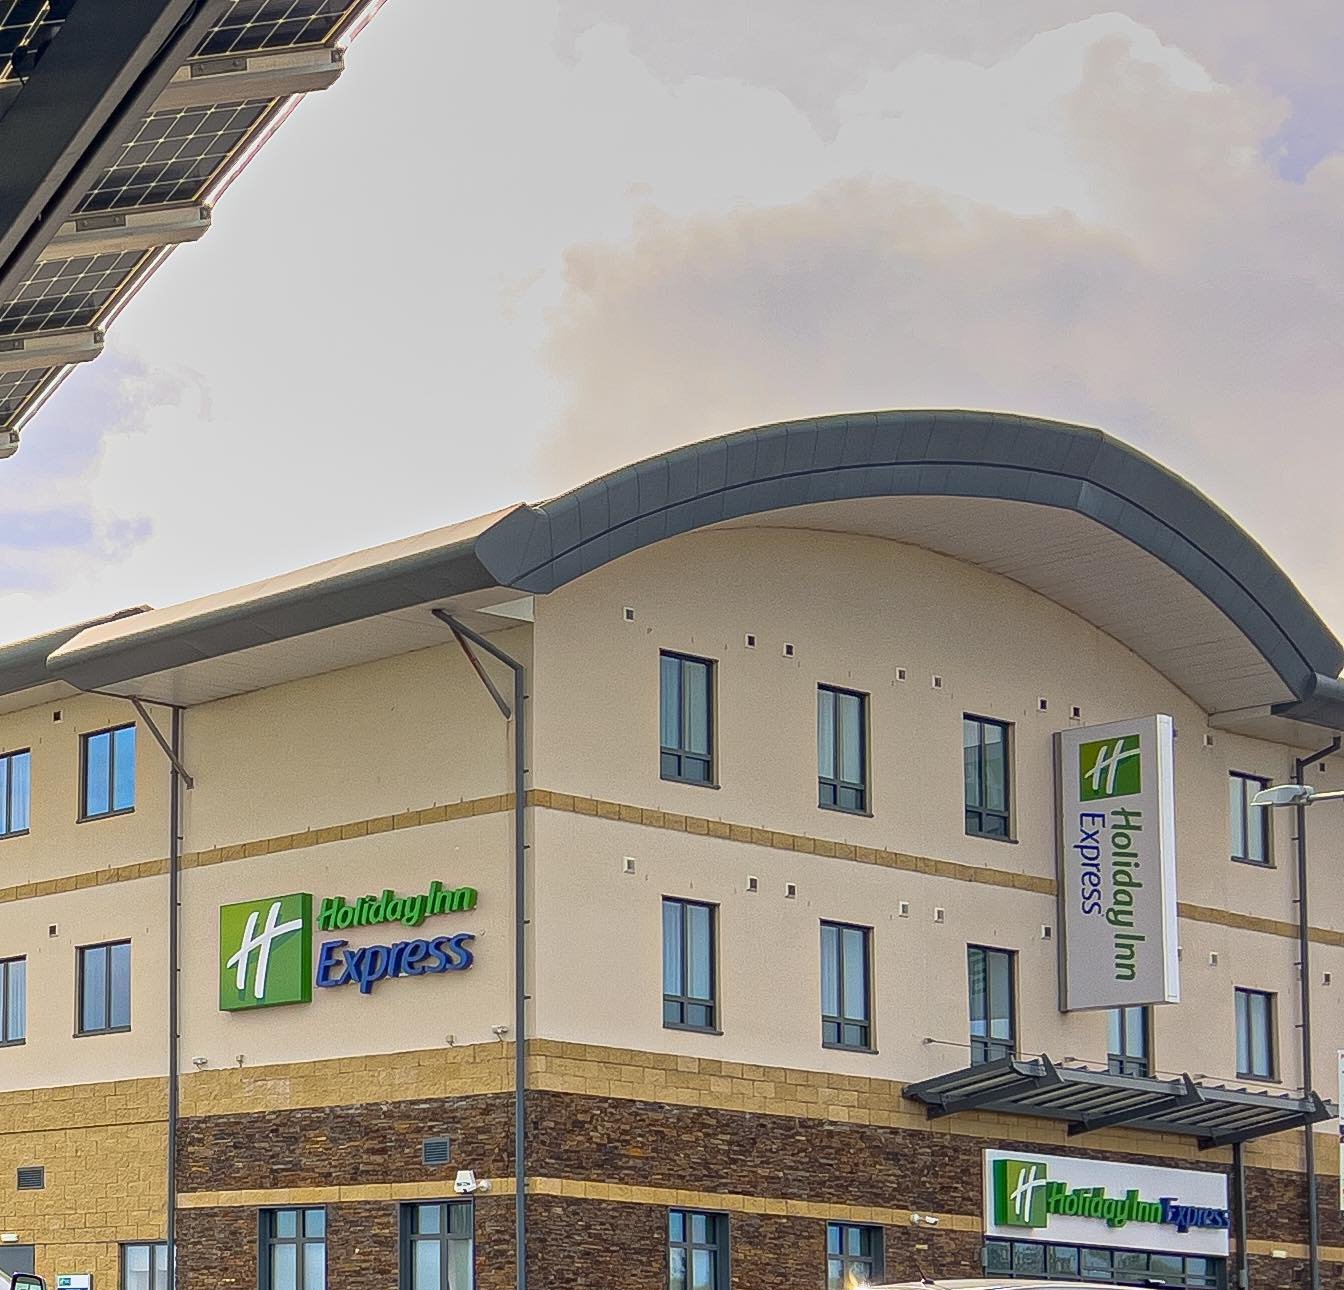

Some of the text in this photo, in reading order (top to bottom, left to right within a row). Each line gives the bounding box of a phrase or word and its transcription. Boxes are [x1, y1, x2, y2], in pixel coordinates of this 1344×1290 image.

[1073, 812, 1105, 914] Express
[1105, 806, 1145, 981] Holiday Inn
[317, 880, 477, 931] Holiday Inn
[315, 933, 475, 994] Express
[1047, 1181, 1230, 1233] Holiday Inn Express
